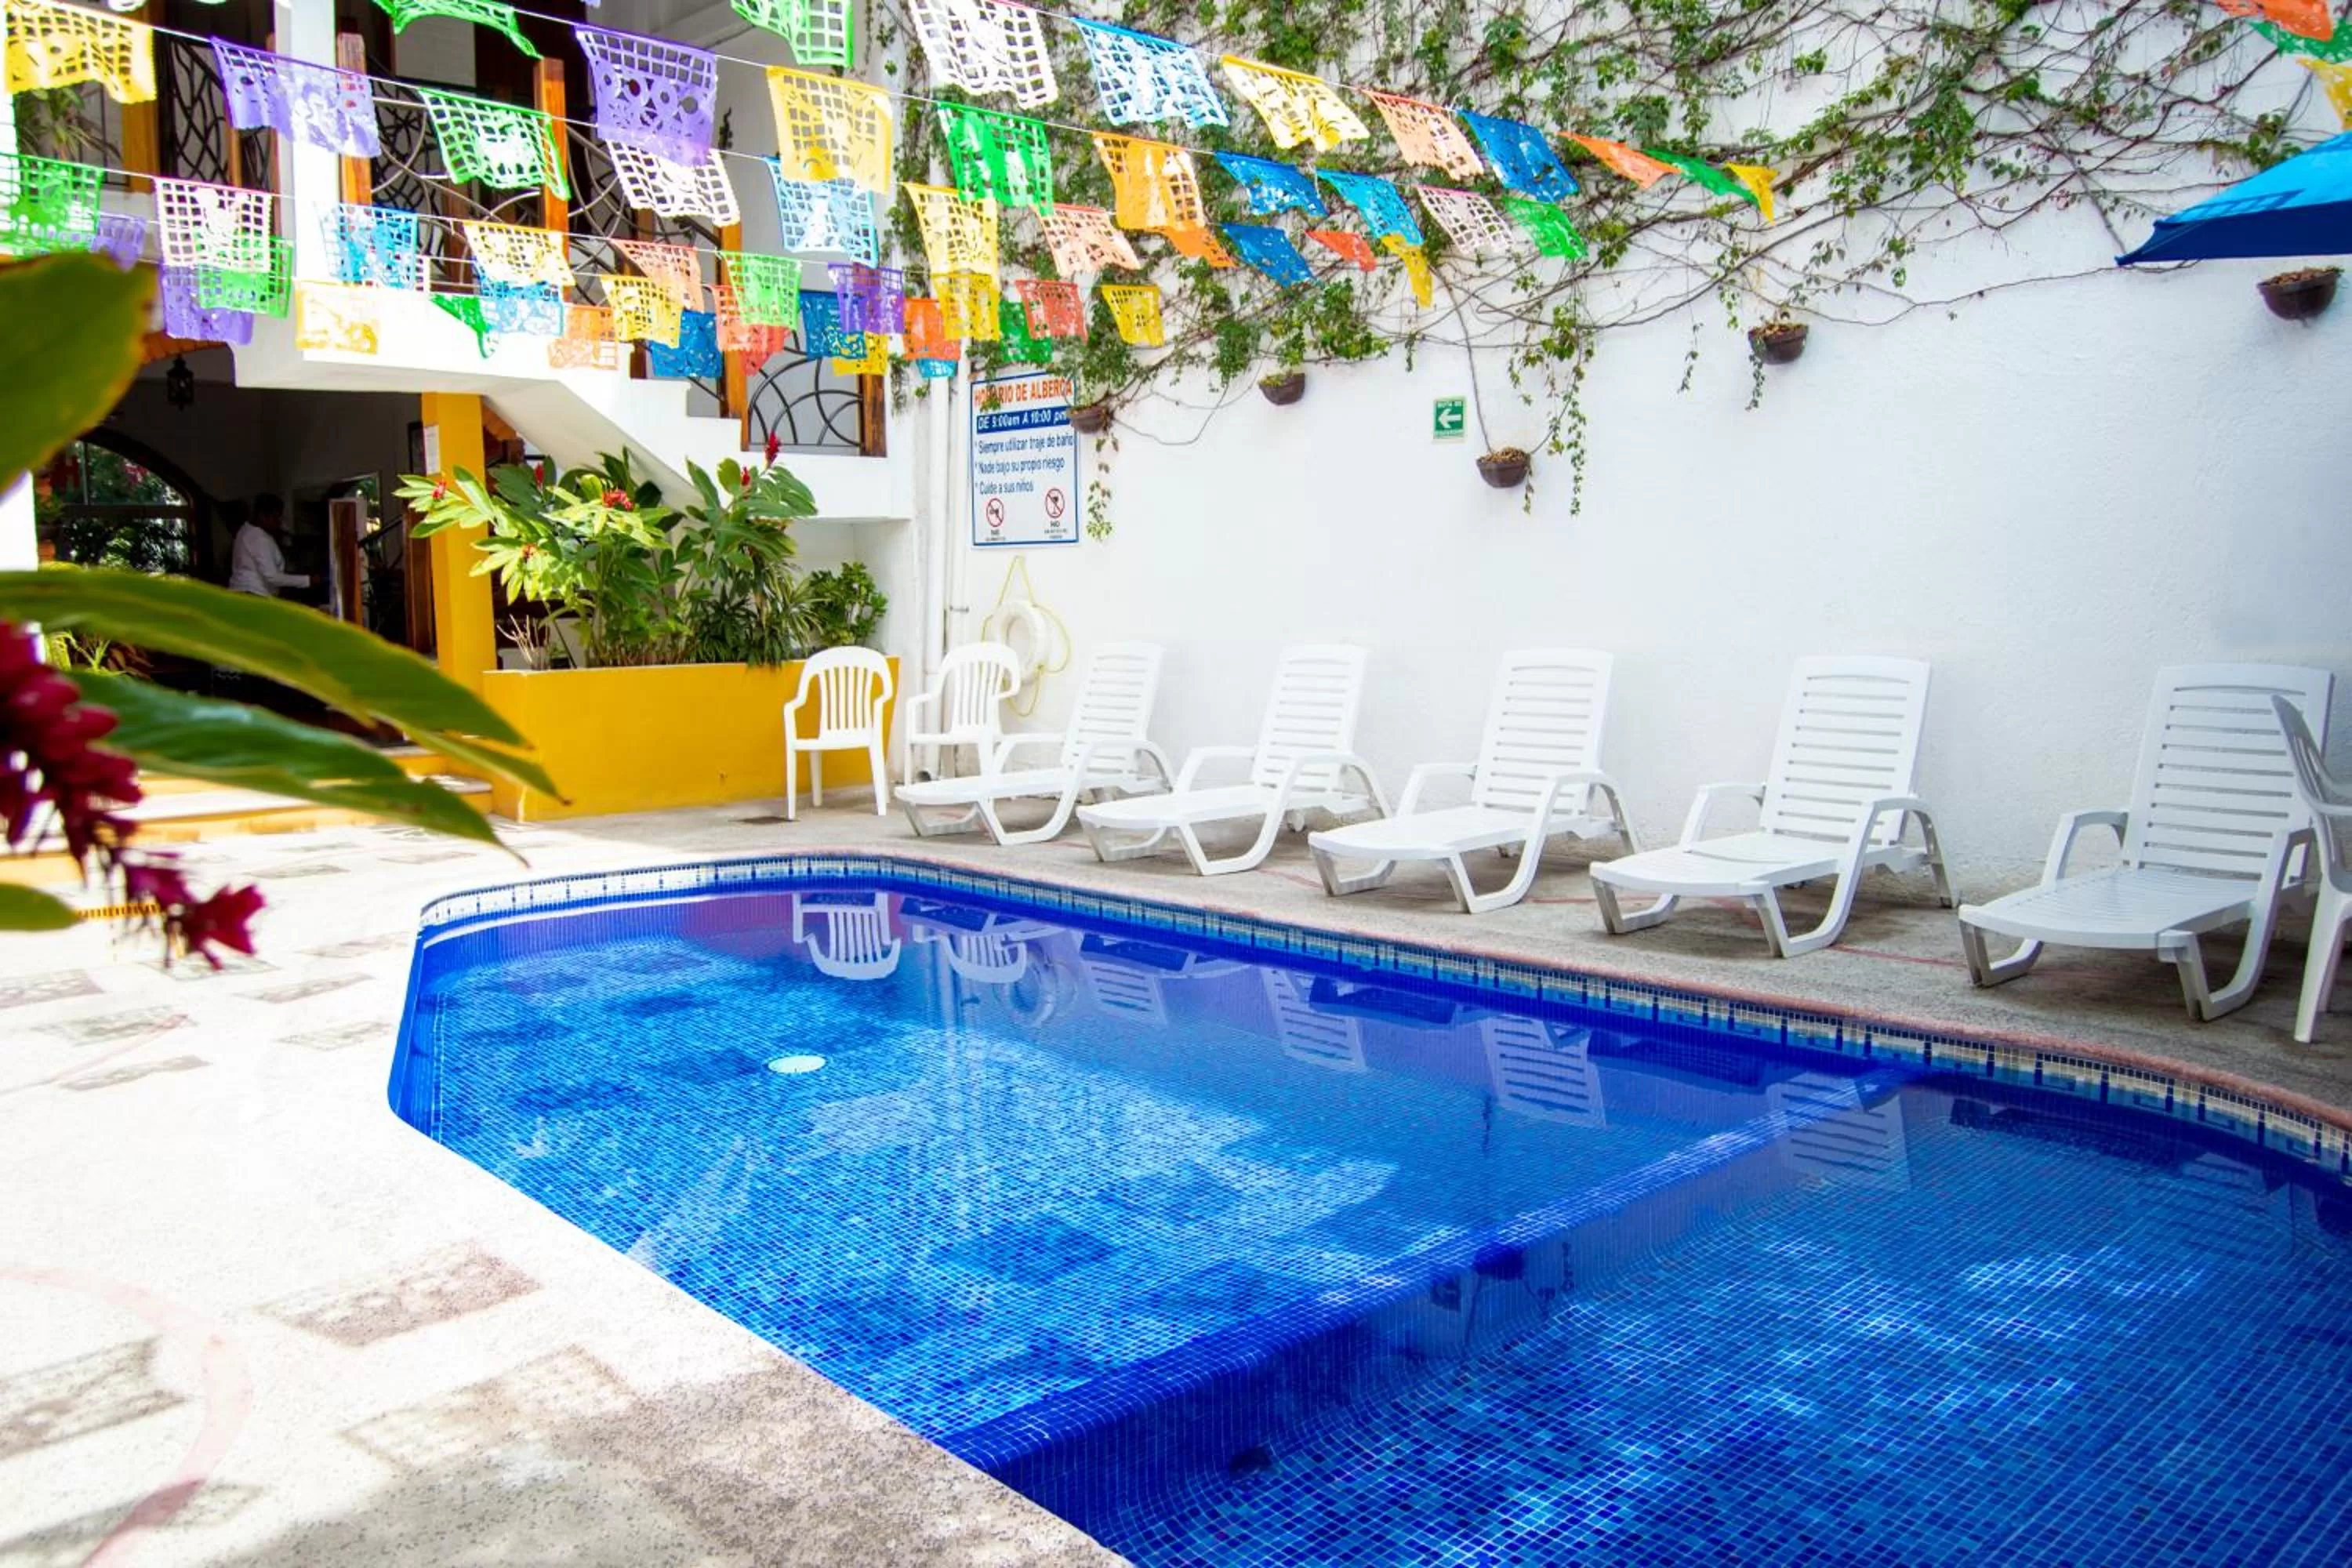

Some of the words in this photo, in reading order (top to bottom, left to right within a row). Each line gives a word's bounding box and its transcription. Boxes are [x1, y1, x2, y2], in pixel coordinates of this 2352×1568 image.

[1016, 383, 1027, 401] DE
[1031, 378, 1073, 399] ALBERCA
[978, 416, 989, 430] DE
[1022, 412, 1029, 425] A
[1031, 409, 1051, 424] 10:00
[978, 440, 1004, 455] Siempre
[1005, 437, 1028, 452] utilizar
[1029, 436, 1045, 452] traje
[1047, 434, 1055, 448] de
[979, 462, 995, 474] Nade
[996, 460, 1010, 476] bajo
[1011, 461, 1019, 472] su
[1020, 459, 1041, 474] propio
[1042, 456, 1065, 474] riesgo
[980, 481, 997, 495] Cuide
[1004, 481, 1015, 494] sus
